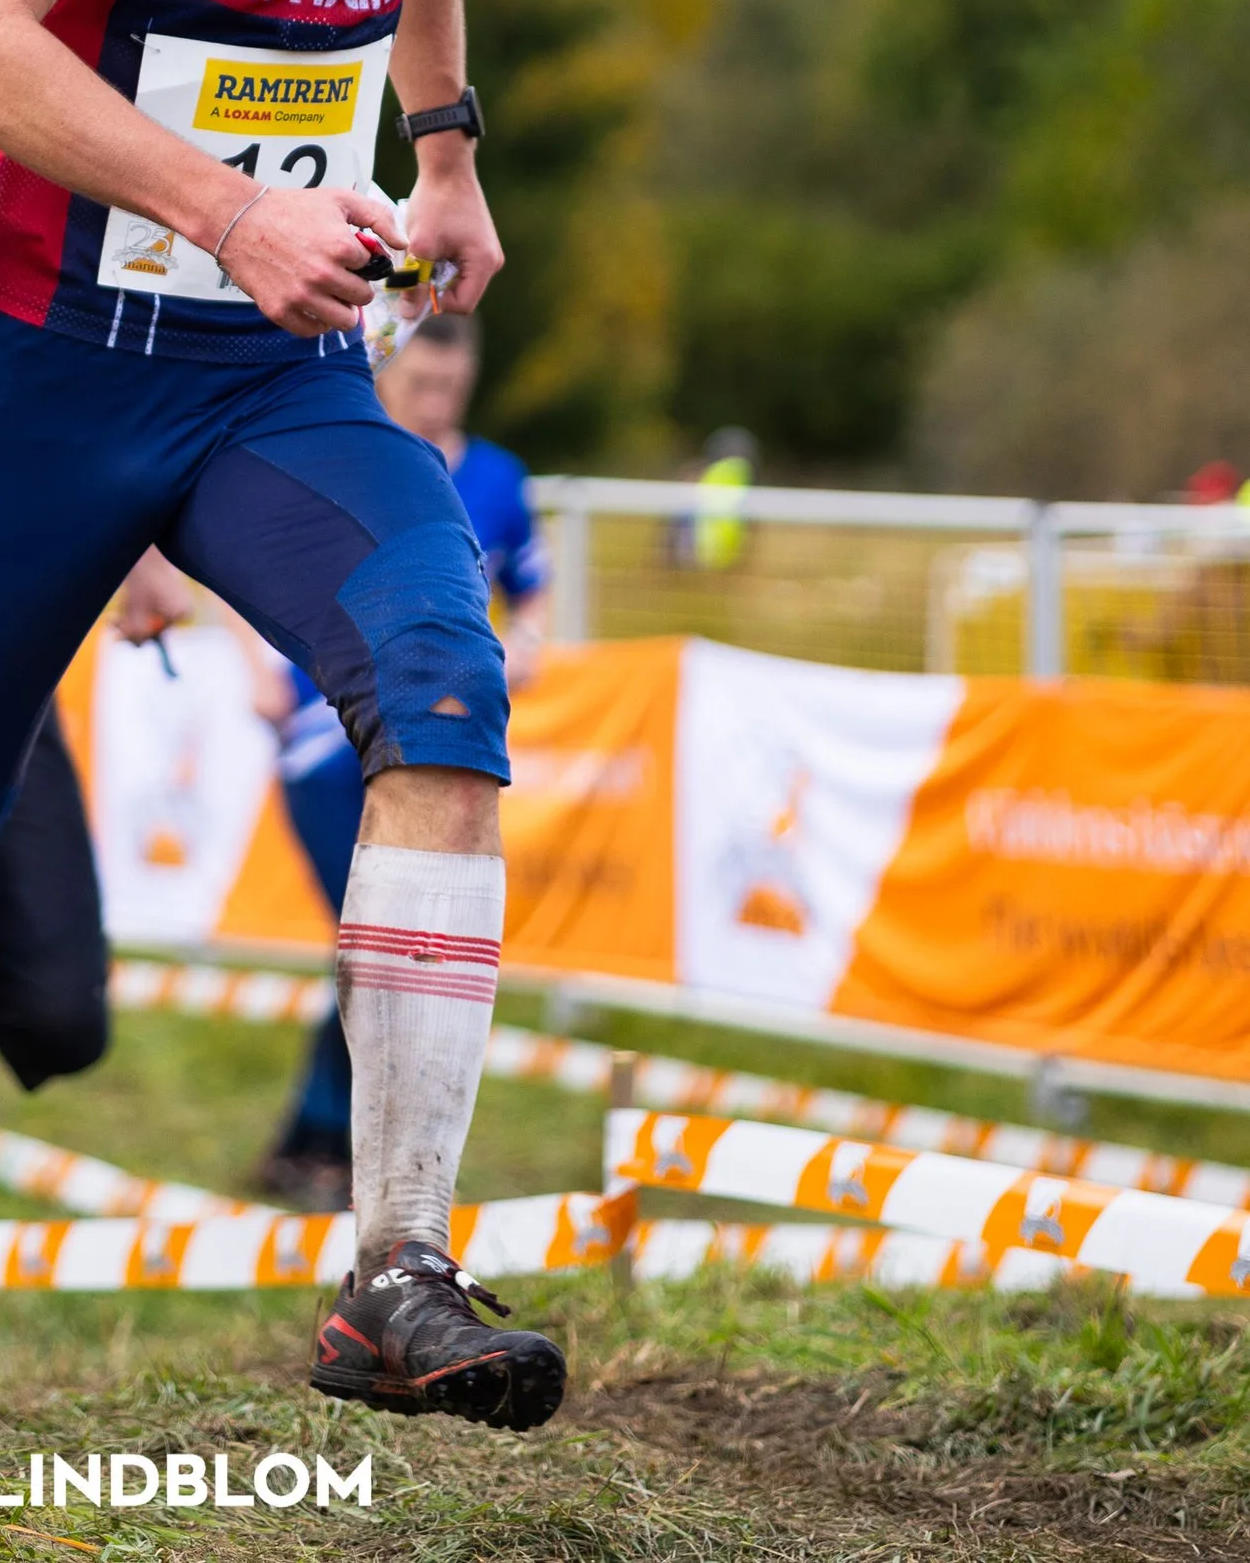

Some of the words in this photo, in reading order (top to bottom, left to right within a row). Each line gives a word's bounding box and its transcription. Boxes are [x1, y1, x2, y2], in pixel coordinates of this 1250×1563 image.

[214, 74, 354, 104] RAMIRENT
[210, 106, 220, 117] A
[224, 108, 272, 121] LOXAM
[274, 110, 325, 124] Company
